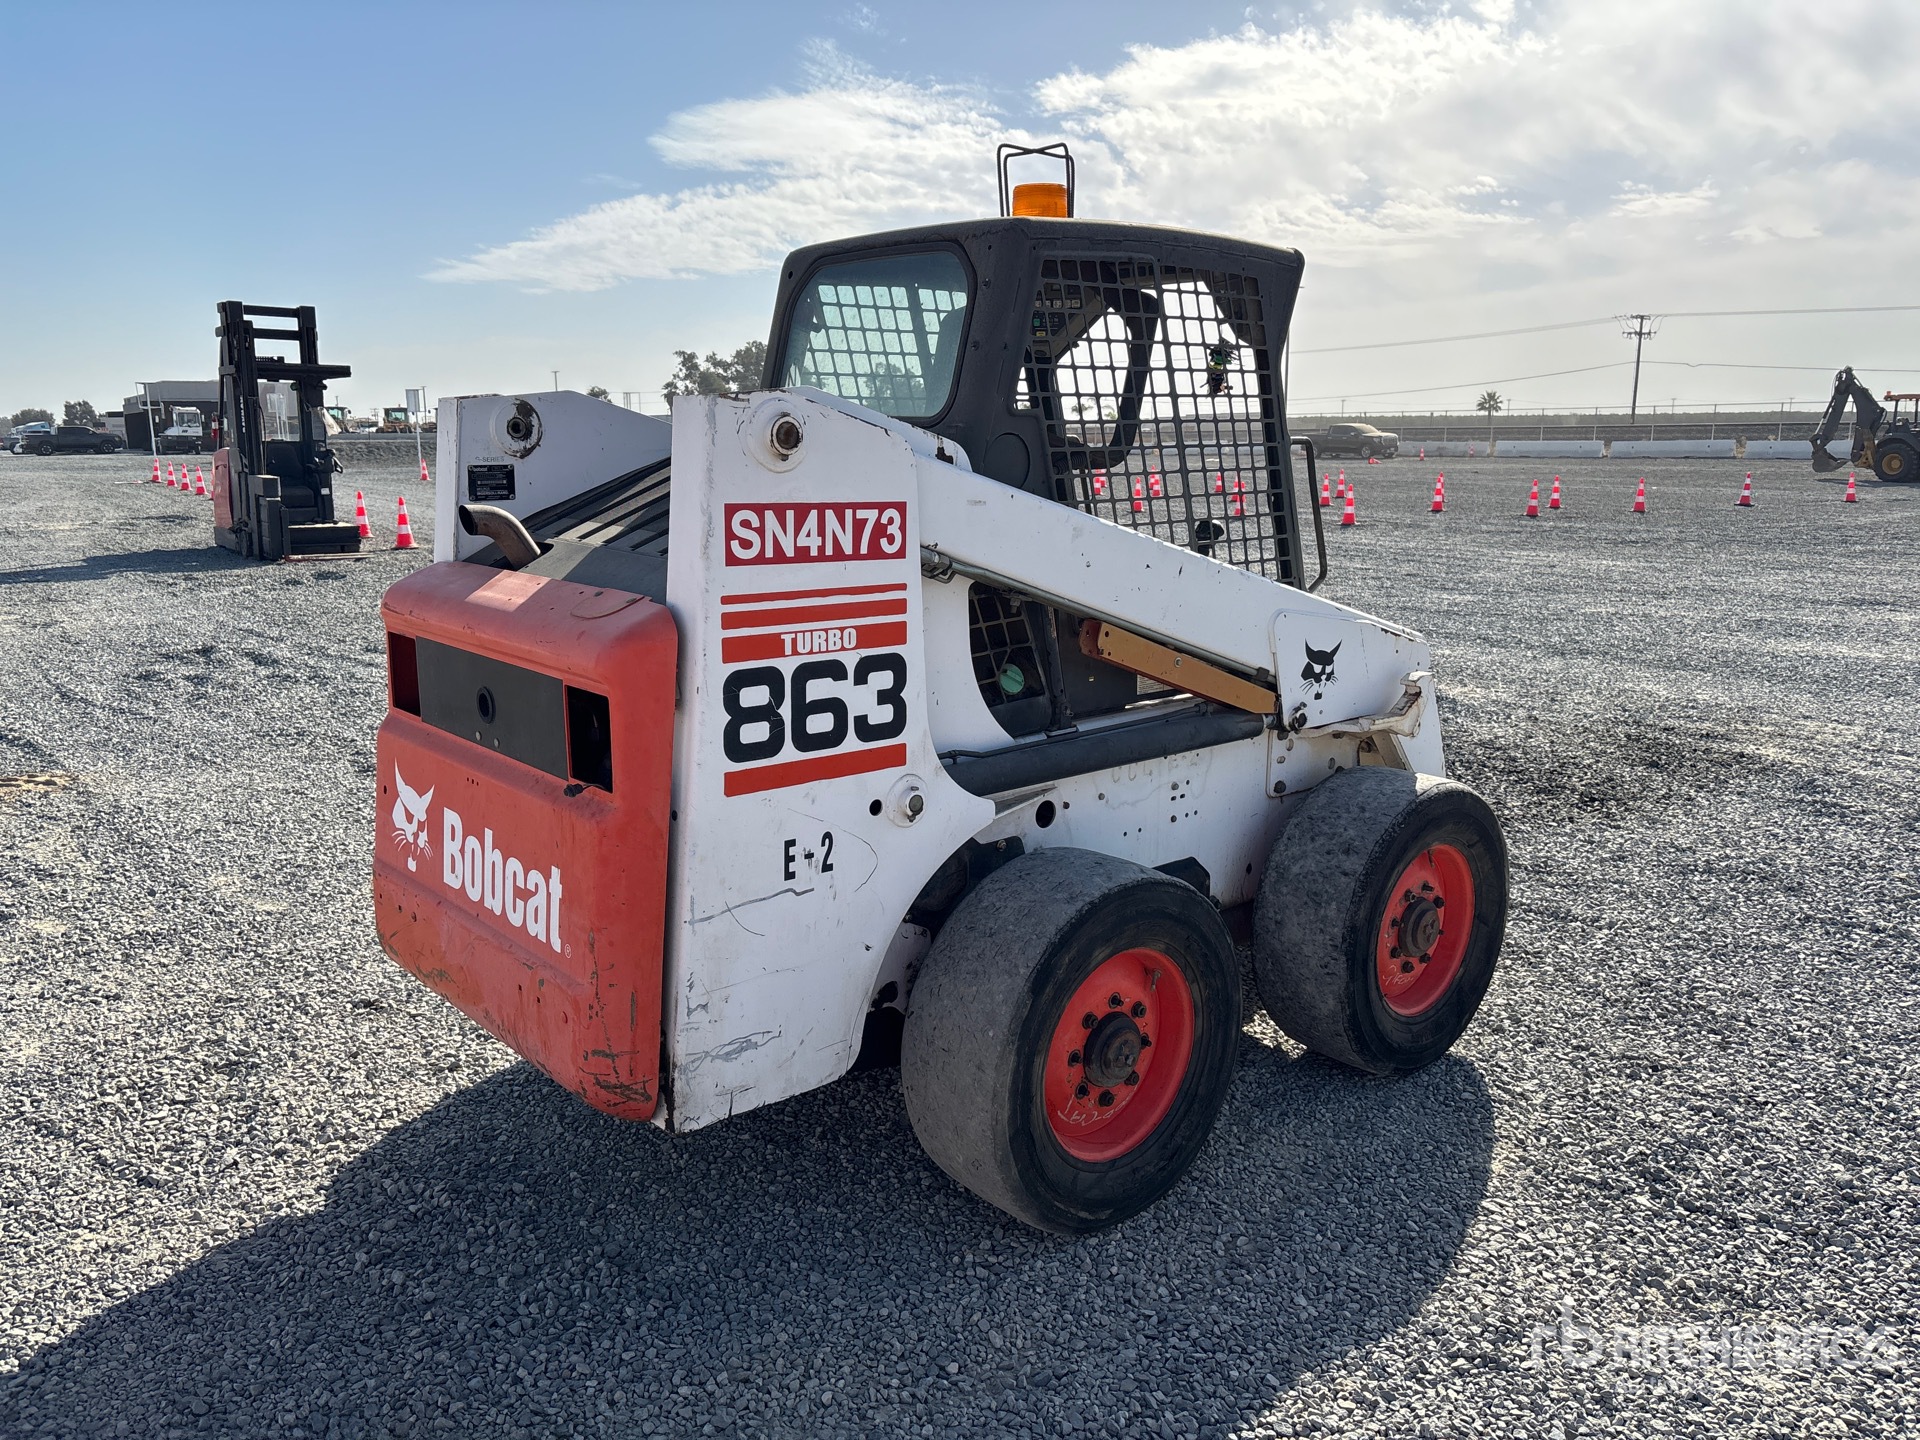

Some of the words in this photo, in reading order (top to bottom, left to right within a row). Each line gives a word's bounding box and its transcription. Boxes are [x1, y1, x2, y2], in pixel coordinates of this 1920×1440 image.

[730, 508, 902, 560] SN4N73
[781, 628, 857, 655] TURBO
[723, 652, 907, 763] 863
[443, 806, 563, 954] Bobcat
